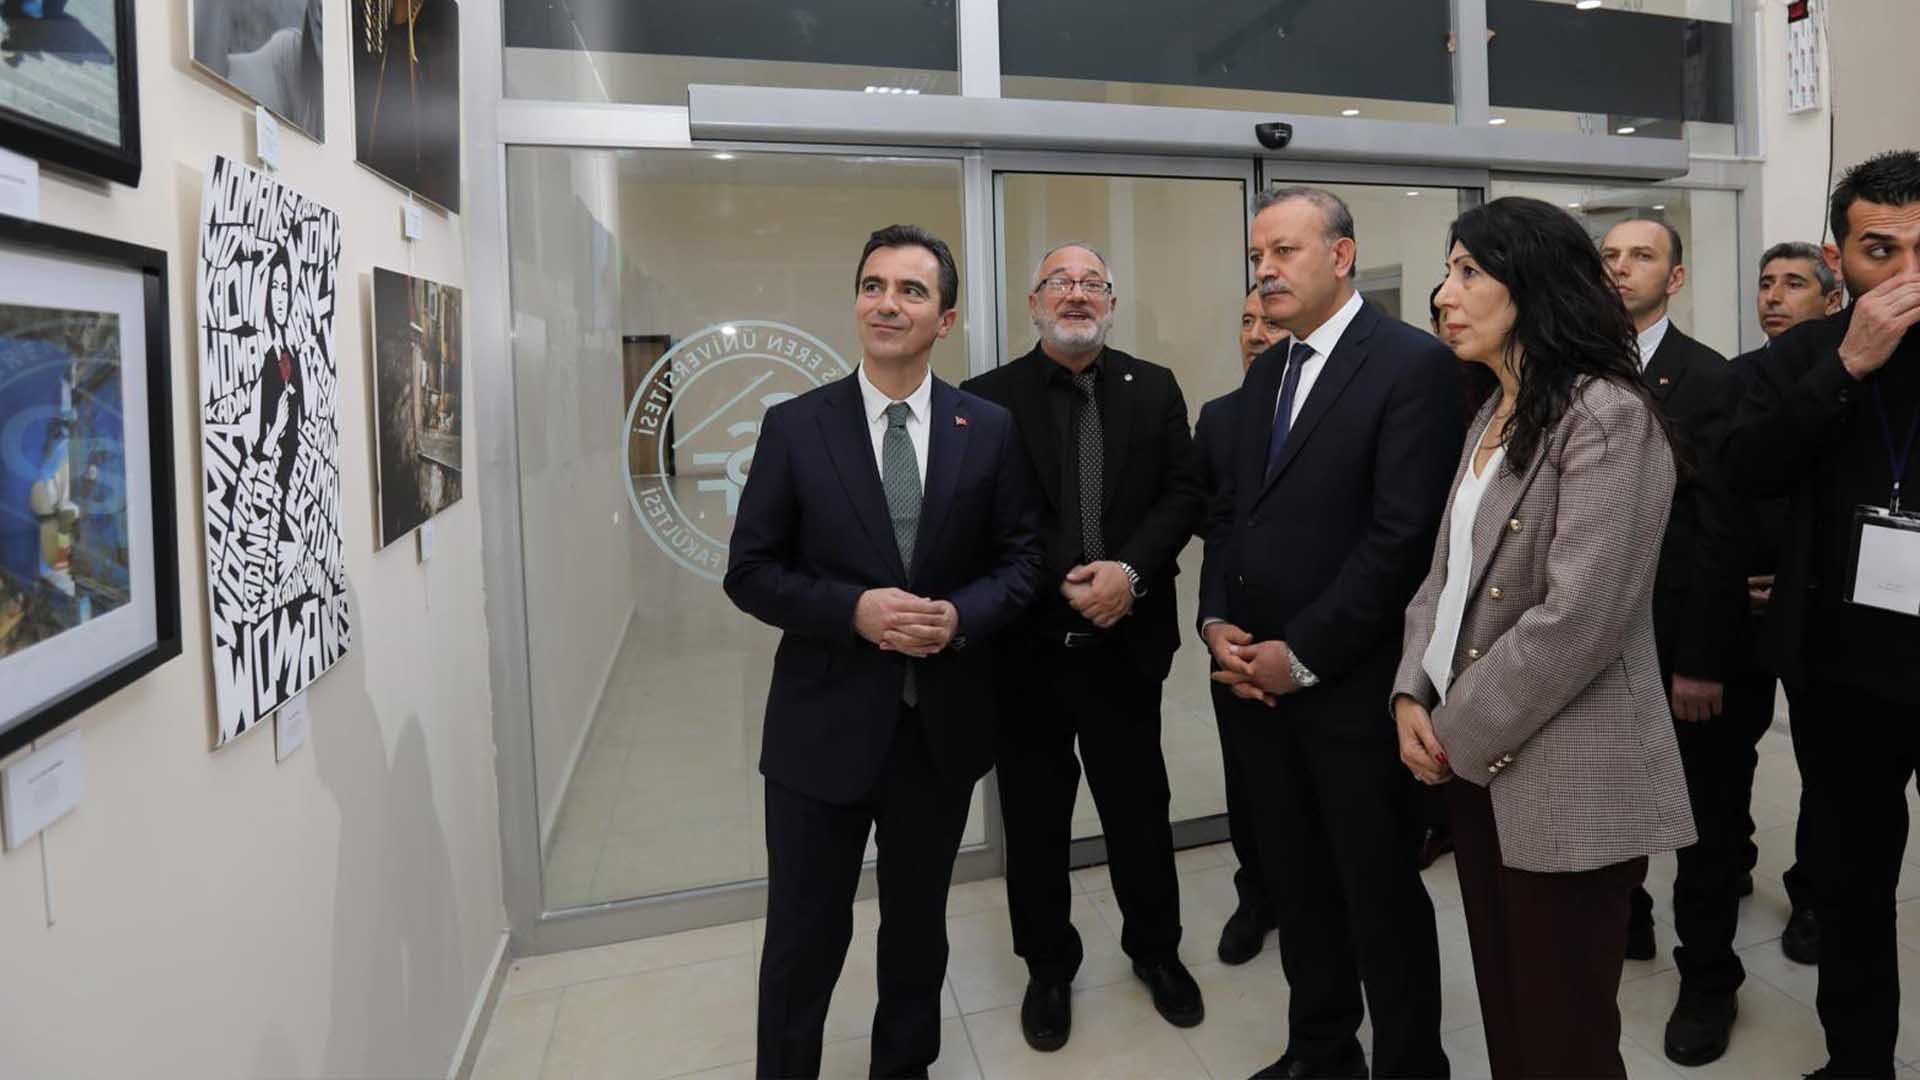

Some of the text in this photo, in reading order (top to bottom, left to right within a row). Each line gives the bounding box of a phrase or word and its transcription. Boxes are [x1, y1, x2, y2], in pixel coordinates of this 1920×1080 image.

[203, 153, 284, 241] WOMAN
[205, 385, 250, 422] KADIN
[214, 456, 258, 647] WOMAN
[242, 538, 267, 623] KADIN
[212, 598, 339, 743] WOMAN
